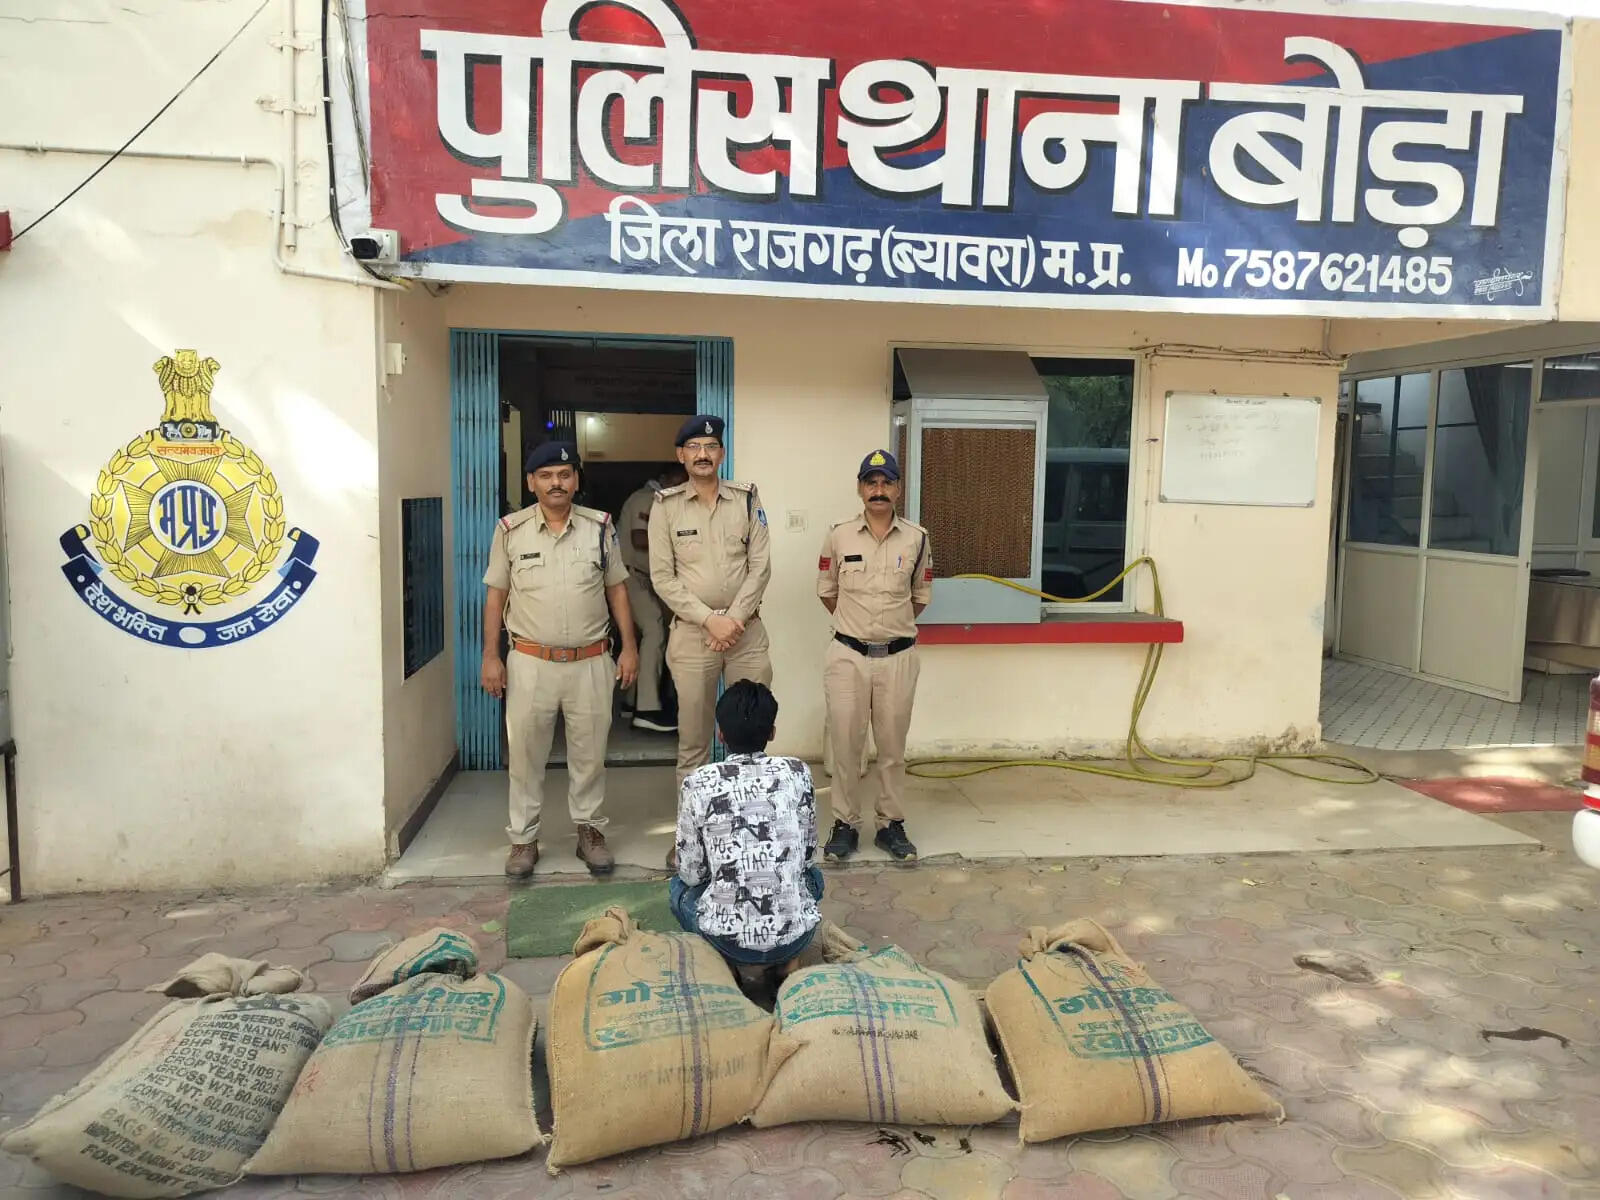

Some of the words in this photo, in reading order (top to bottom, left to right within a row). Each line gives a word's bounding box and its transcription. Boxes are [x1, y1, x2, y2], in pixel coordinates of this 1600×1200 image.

[420, 0, 833, 237] पुलिस
[837, 58, 1204, 218] थाना
[1208, 36, 1524, 250] बोड़ा
[603, 194, 723, 275] जिला
[1176, 247, 1219, 289] Mo
[1222, 248, 1453, 296] 7587621485
[240, 1014, 286, 1028] SEEDS
[178, 1036, 213, 1049] BHP
[184, 1029, 241, 1042] COFFEE
[241, 1033, 289, 1055] BEANS
[164, 1054, 206, 1069] CROP
[155, 1063, 208, 1086] GROSS
